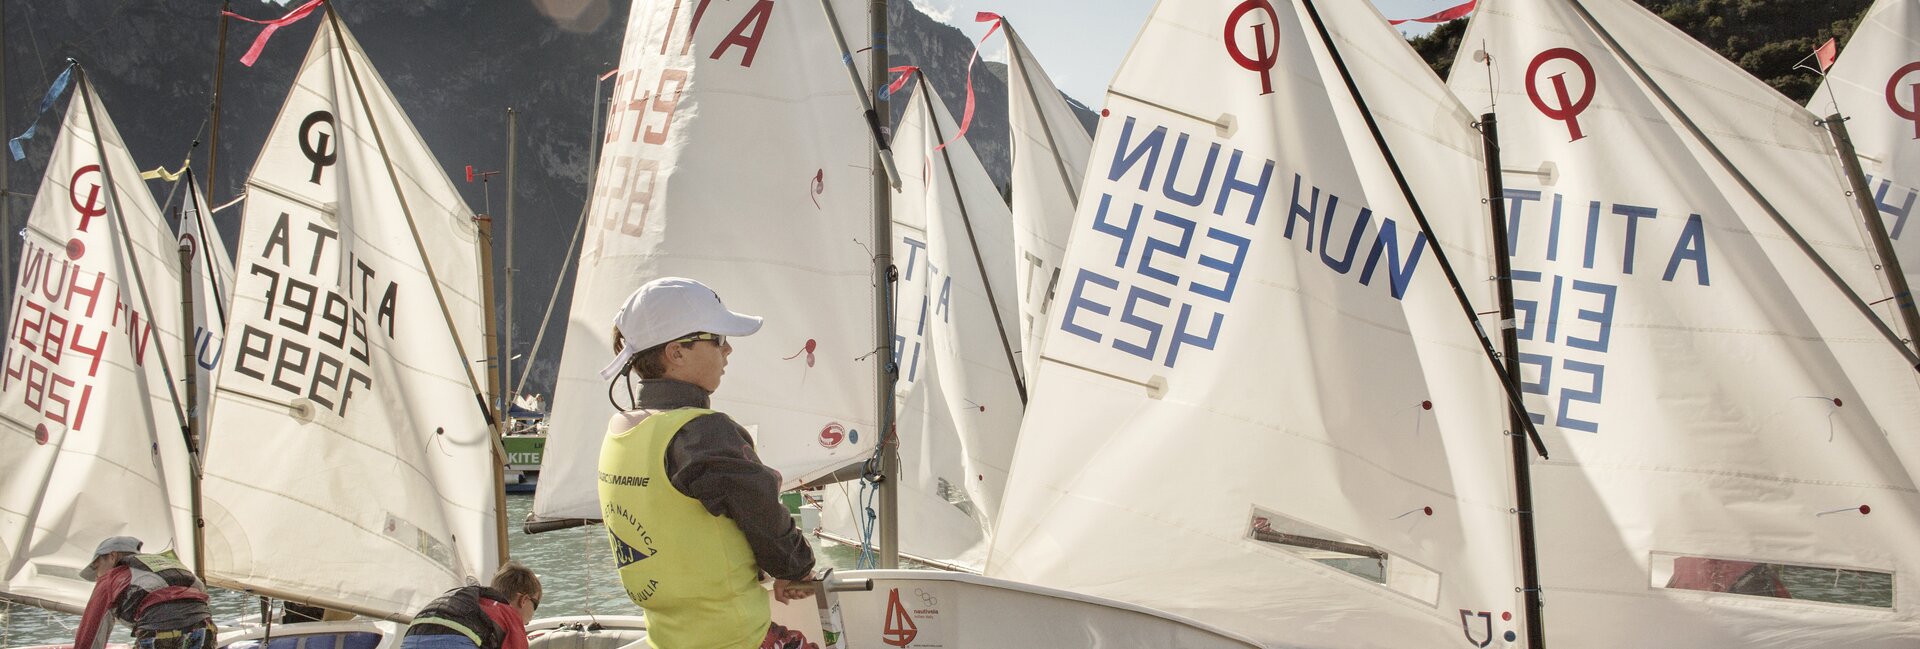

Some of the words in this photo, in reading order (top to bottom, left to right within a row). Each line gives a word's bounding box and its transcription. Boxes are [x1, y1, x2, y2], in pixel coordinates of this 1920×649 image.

[1092, 193, 1251, 304] 423
[1283, 173, 1428, 301] HUN
[508, 452, 540, 464] KITE
[616, 503, 658, 557] NAUTICA
